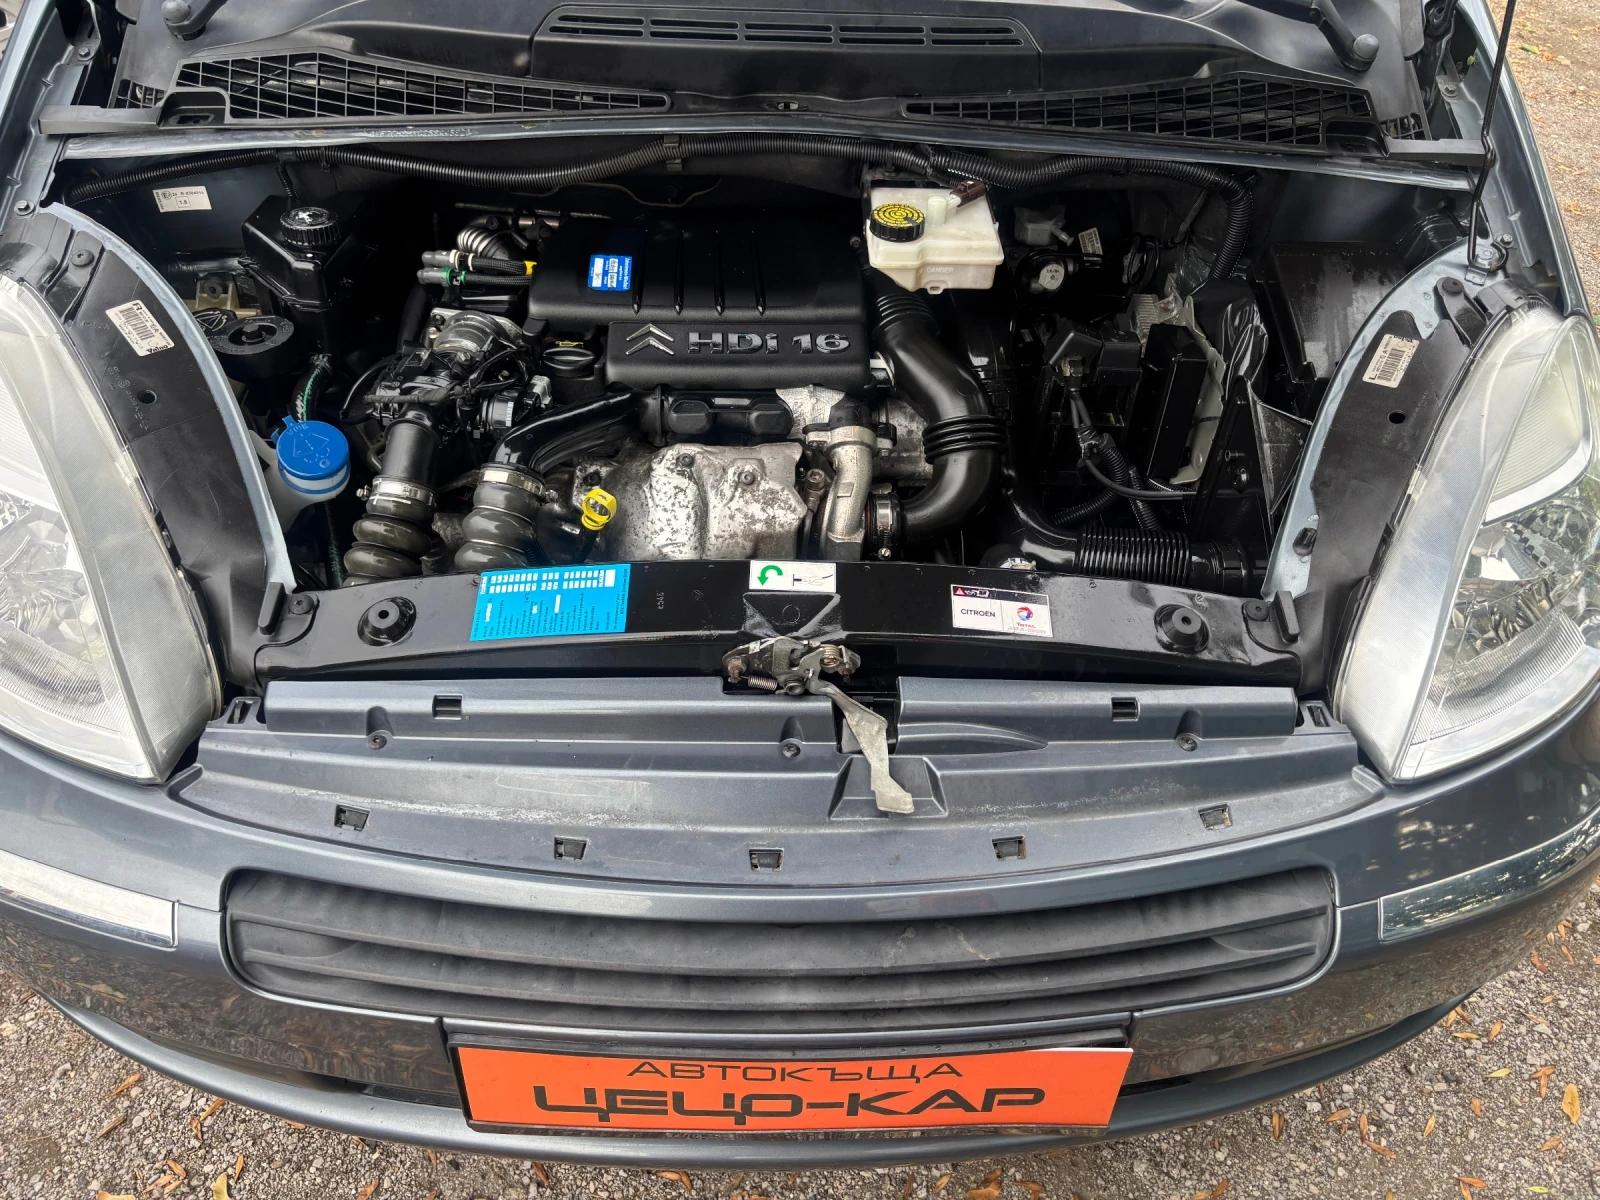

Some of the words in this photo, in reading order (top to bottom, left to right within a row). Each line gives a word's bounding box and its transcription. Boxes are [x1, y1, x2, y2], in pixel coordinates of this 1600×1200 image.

[688, 332, 779, 354] HDi
[791, 333, 850, 354] 16
[627, 1061, 963, 1083] АВТОКЪЩА
[533, 1085, 1047, 1126] ЦЕЦО-КАР
